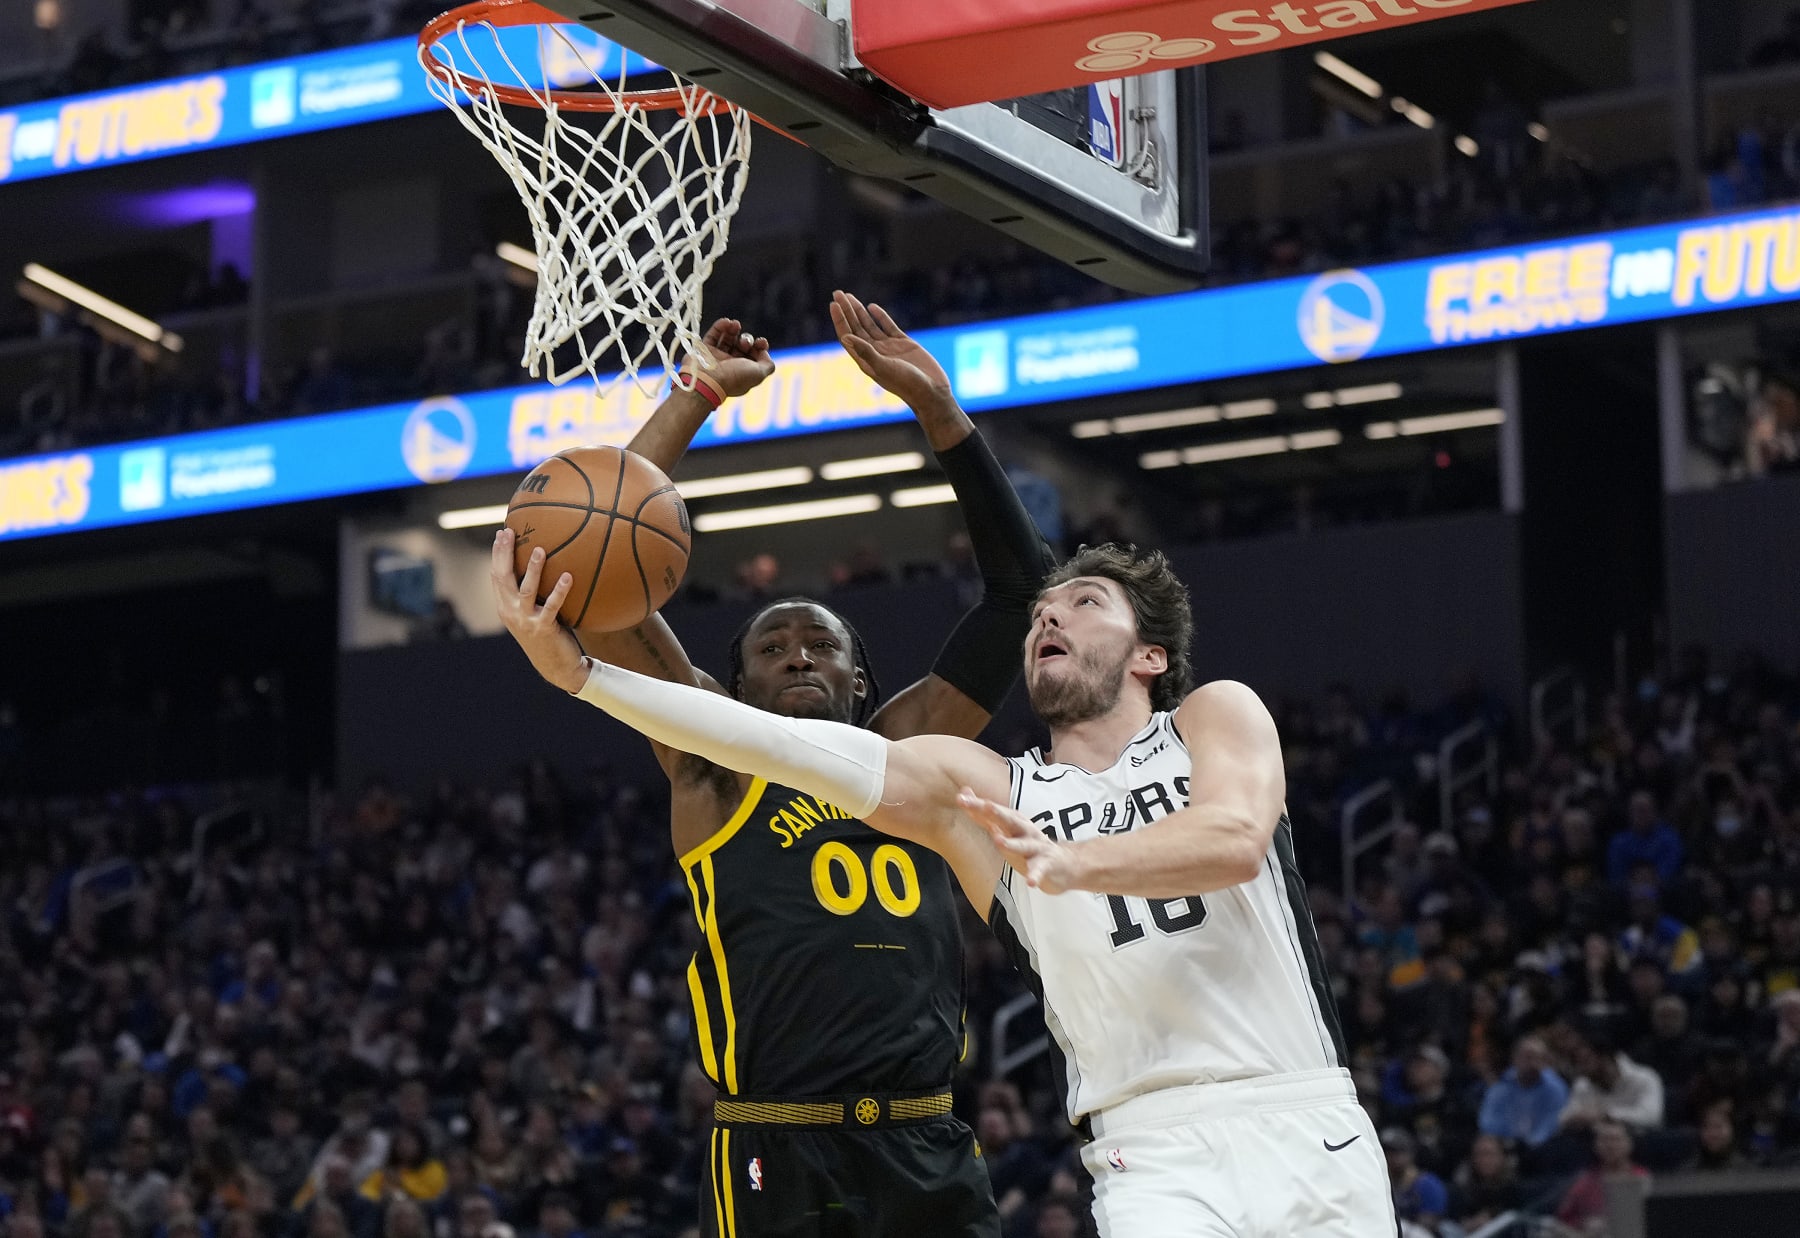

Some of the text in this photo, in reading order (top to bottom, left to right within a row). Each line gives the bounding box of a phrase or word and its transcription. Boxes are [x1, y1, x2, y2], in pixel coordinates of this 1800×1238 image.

[1427, 242, 1613, 310] FREE
[769, 796, 824, 848] SAN
[811, 841, 921, 917] 00
